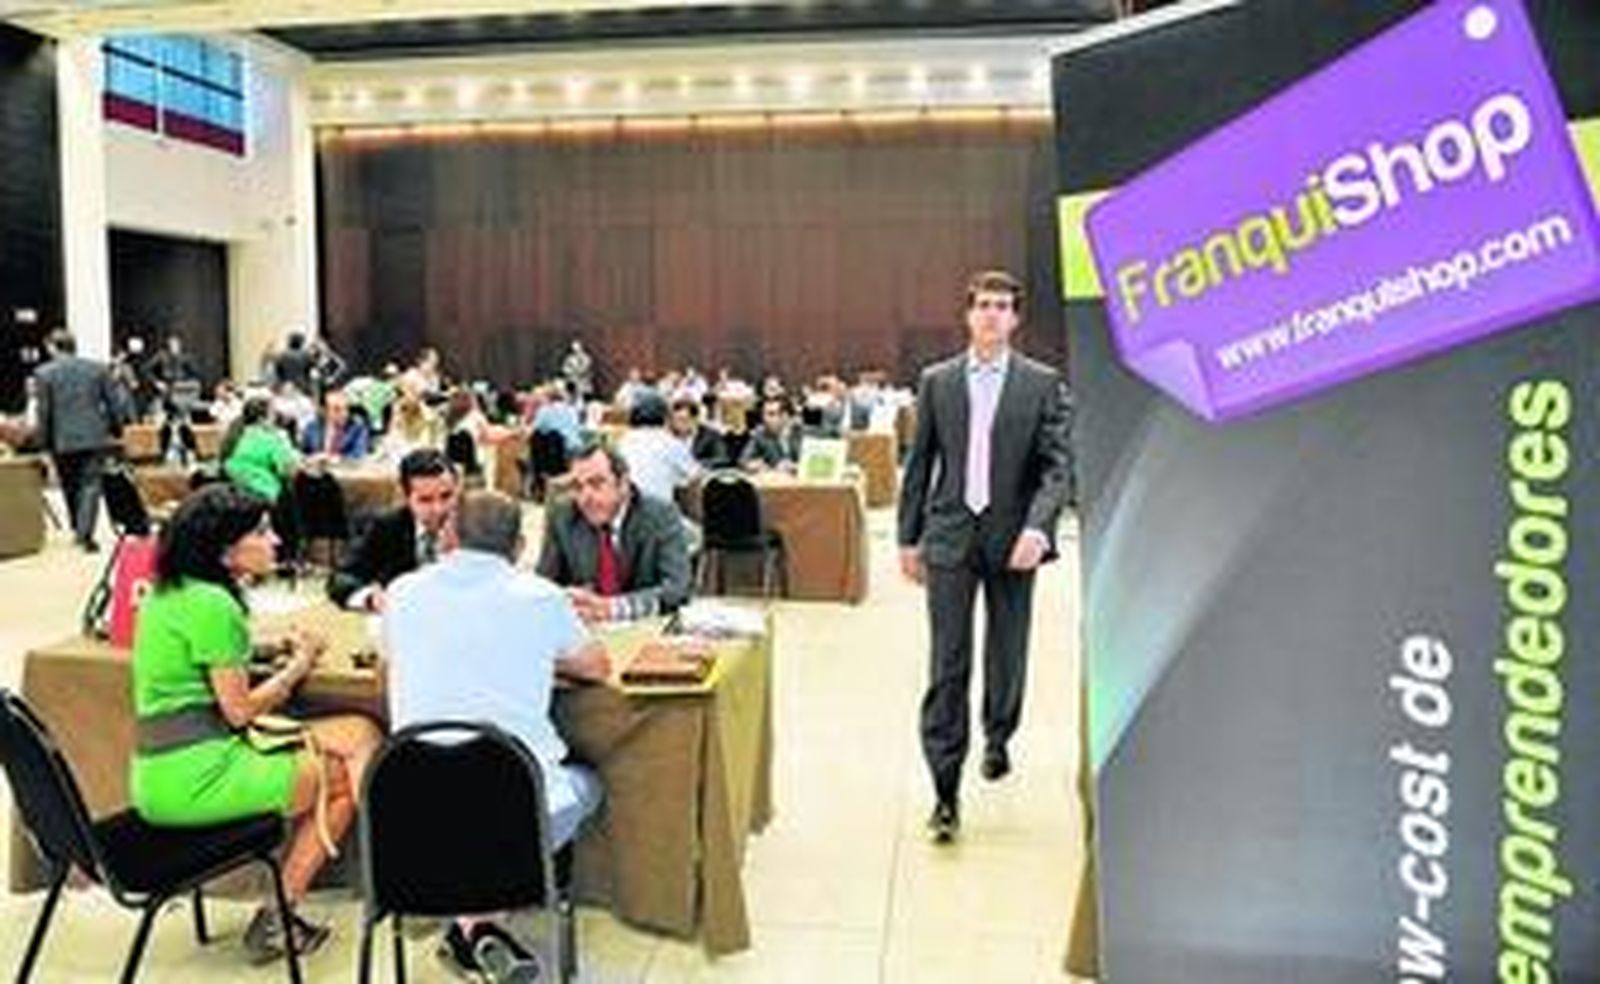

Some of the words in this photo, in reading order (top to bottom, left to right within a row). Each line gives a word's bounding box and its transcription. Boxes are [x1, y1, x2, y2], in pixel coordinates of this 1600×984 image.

[1118, 94, 1532, 324] FranquiShop
[1217, 215, 1572, 370] www.franquishop.com
[1389, 635, 1453, 728] de
[1494, 380, 1572, 984] emprendedores
[1389, 742, 1449, 984] w-cost
